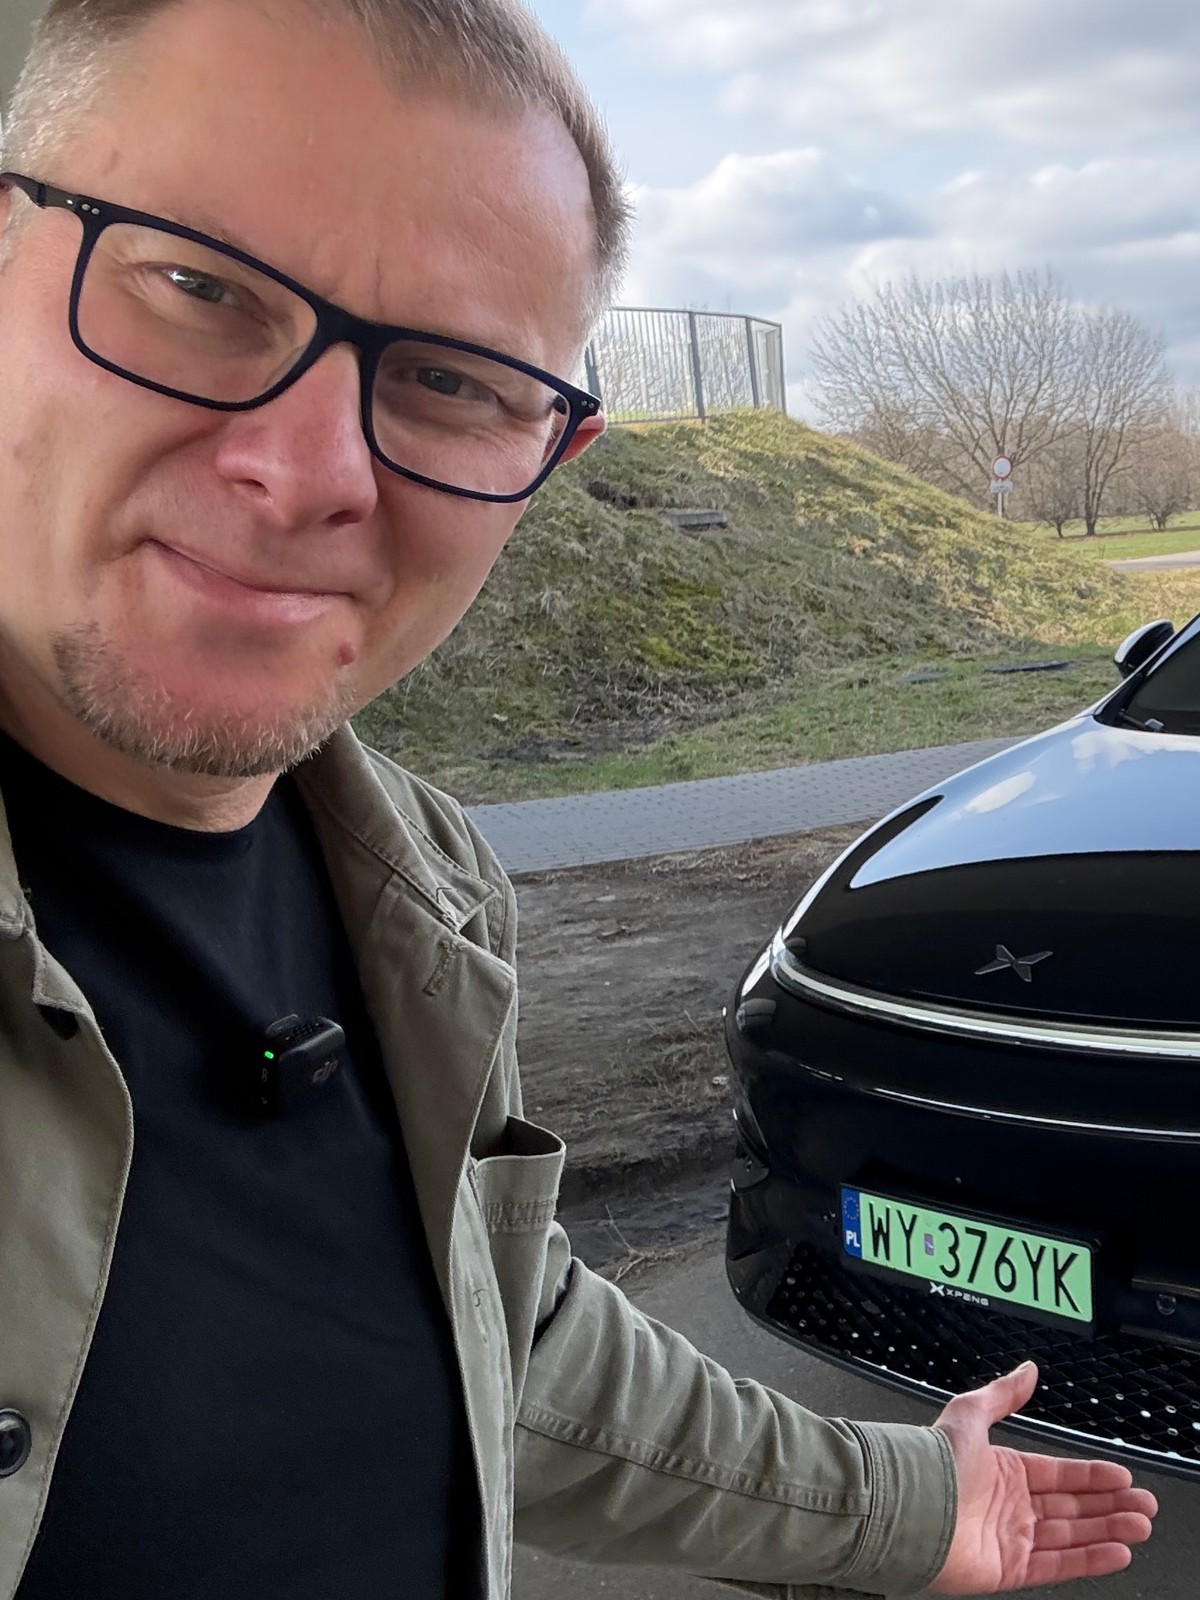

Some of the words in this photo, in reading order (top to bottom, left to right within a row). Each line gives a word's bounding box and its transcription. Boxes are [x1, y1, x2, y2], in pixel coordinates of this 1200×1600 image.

[846, 1230, 861, 1248] PL
[869, 1202, 917, 1268] WY
[938, 1222, 1081, 1313] 376YK
[946, 1289, 990, 1306] XPENG
